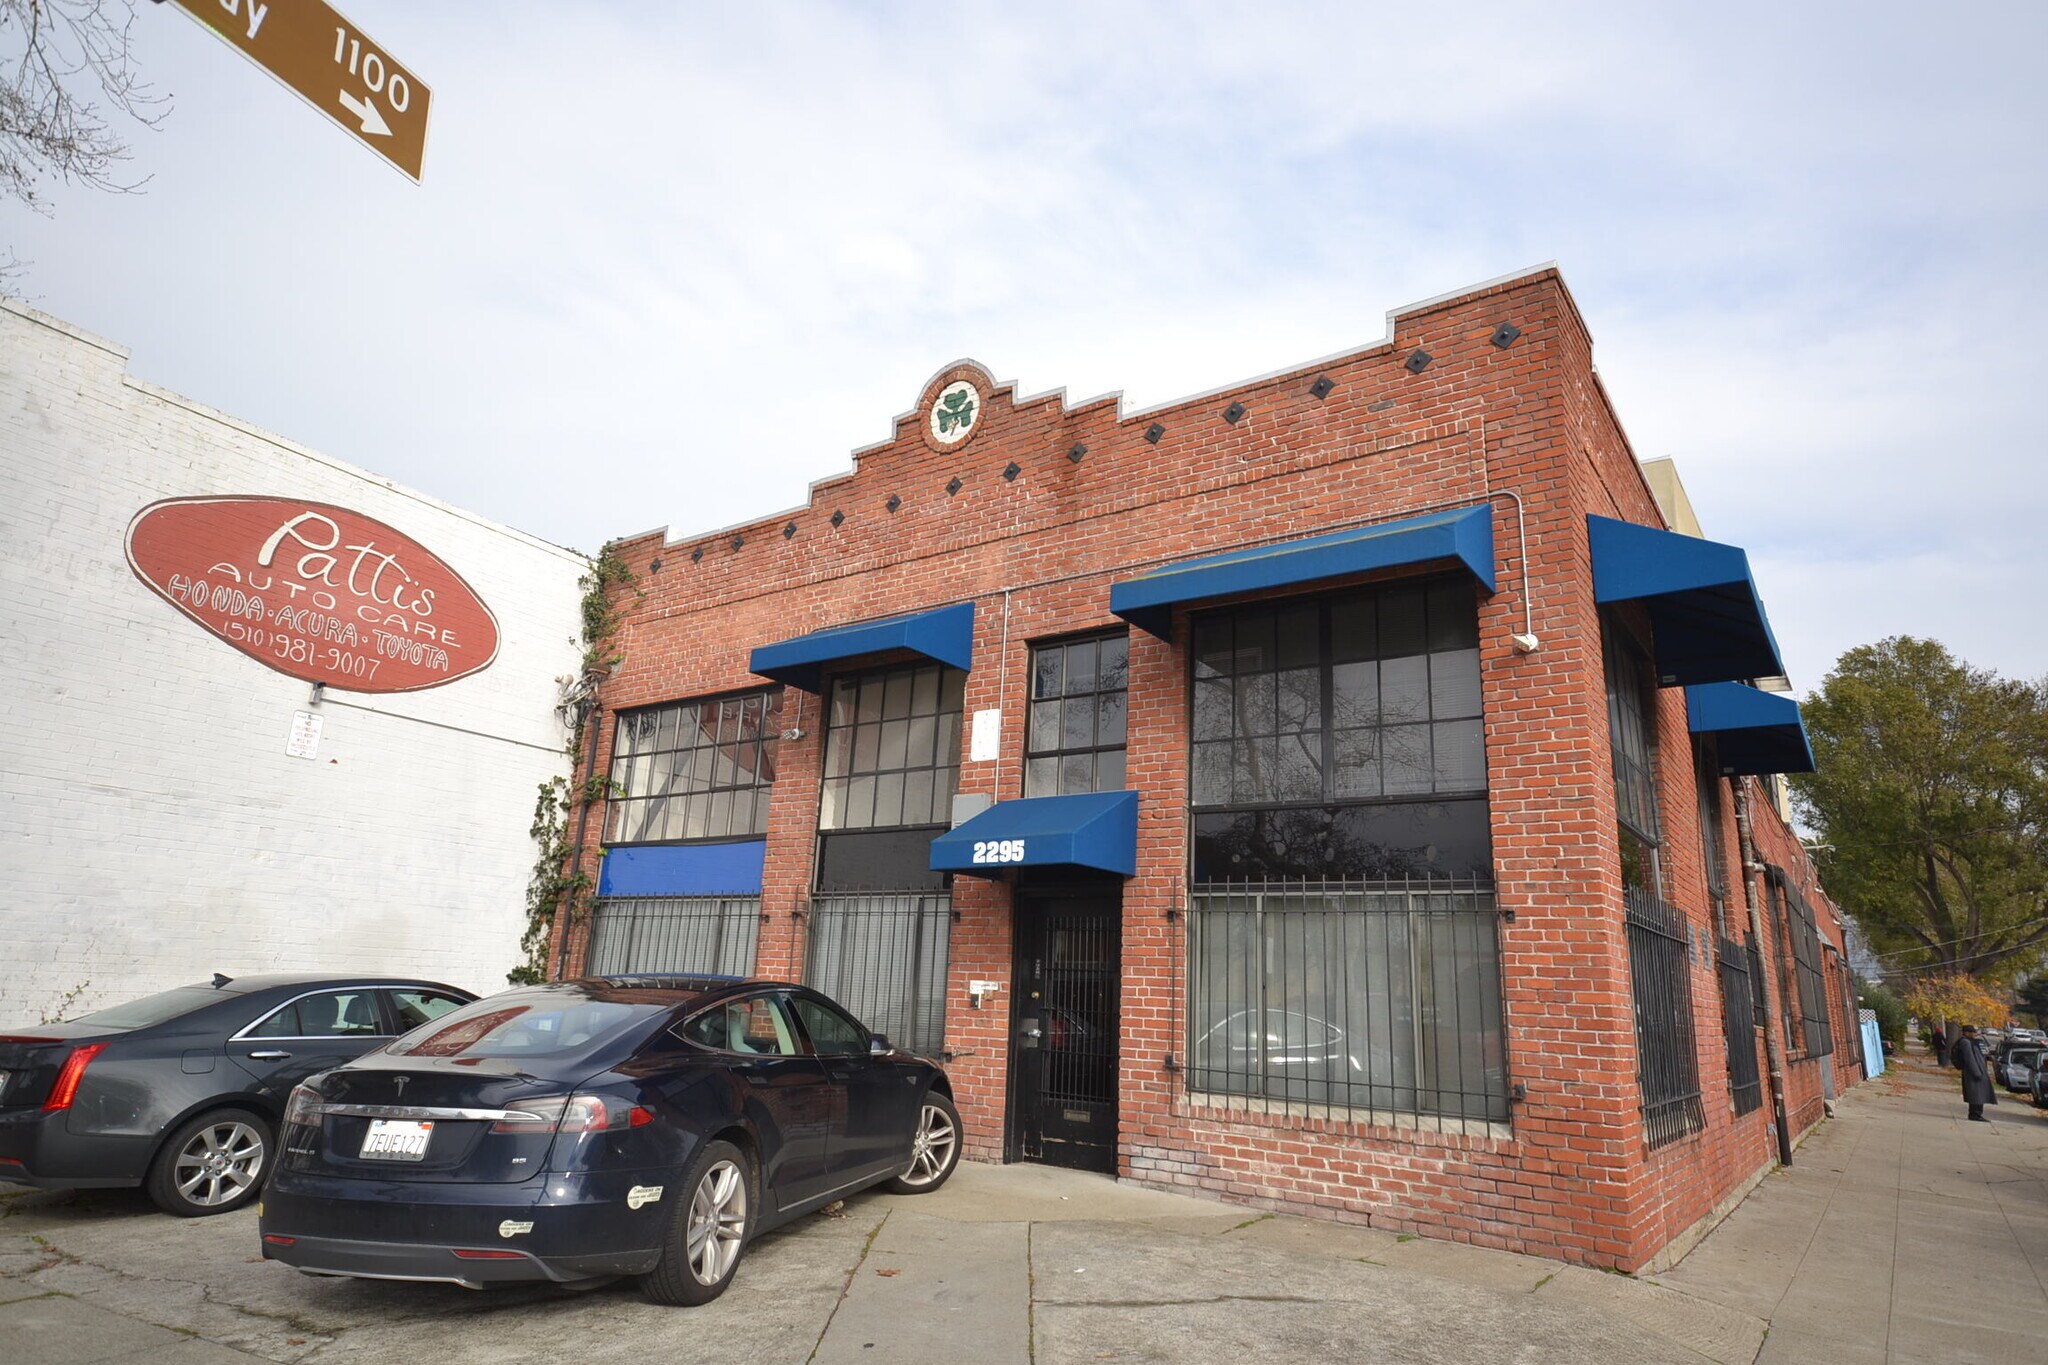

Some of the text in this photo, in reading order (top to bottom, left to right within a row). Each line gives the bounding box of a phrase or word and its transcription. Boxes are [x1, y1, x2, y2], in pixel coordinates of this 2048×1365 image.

[334, 27, 410, 113] 1100
[207, 562, 461, 648] AUTO CARE
[257, 511, 436, 616] Patti's
[167, 573, 449, 672] HONDA ACURA TOYOTA
[972, 839, 1025, 864] 2295
[368, 1133, 425, 1154] 7EUE127
